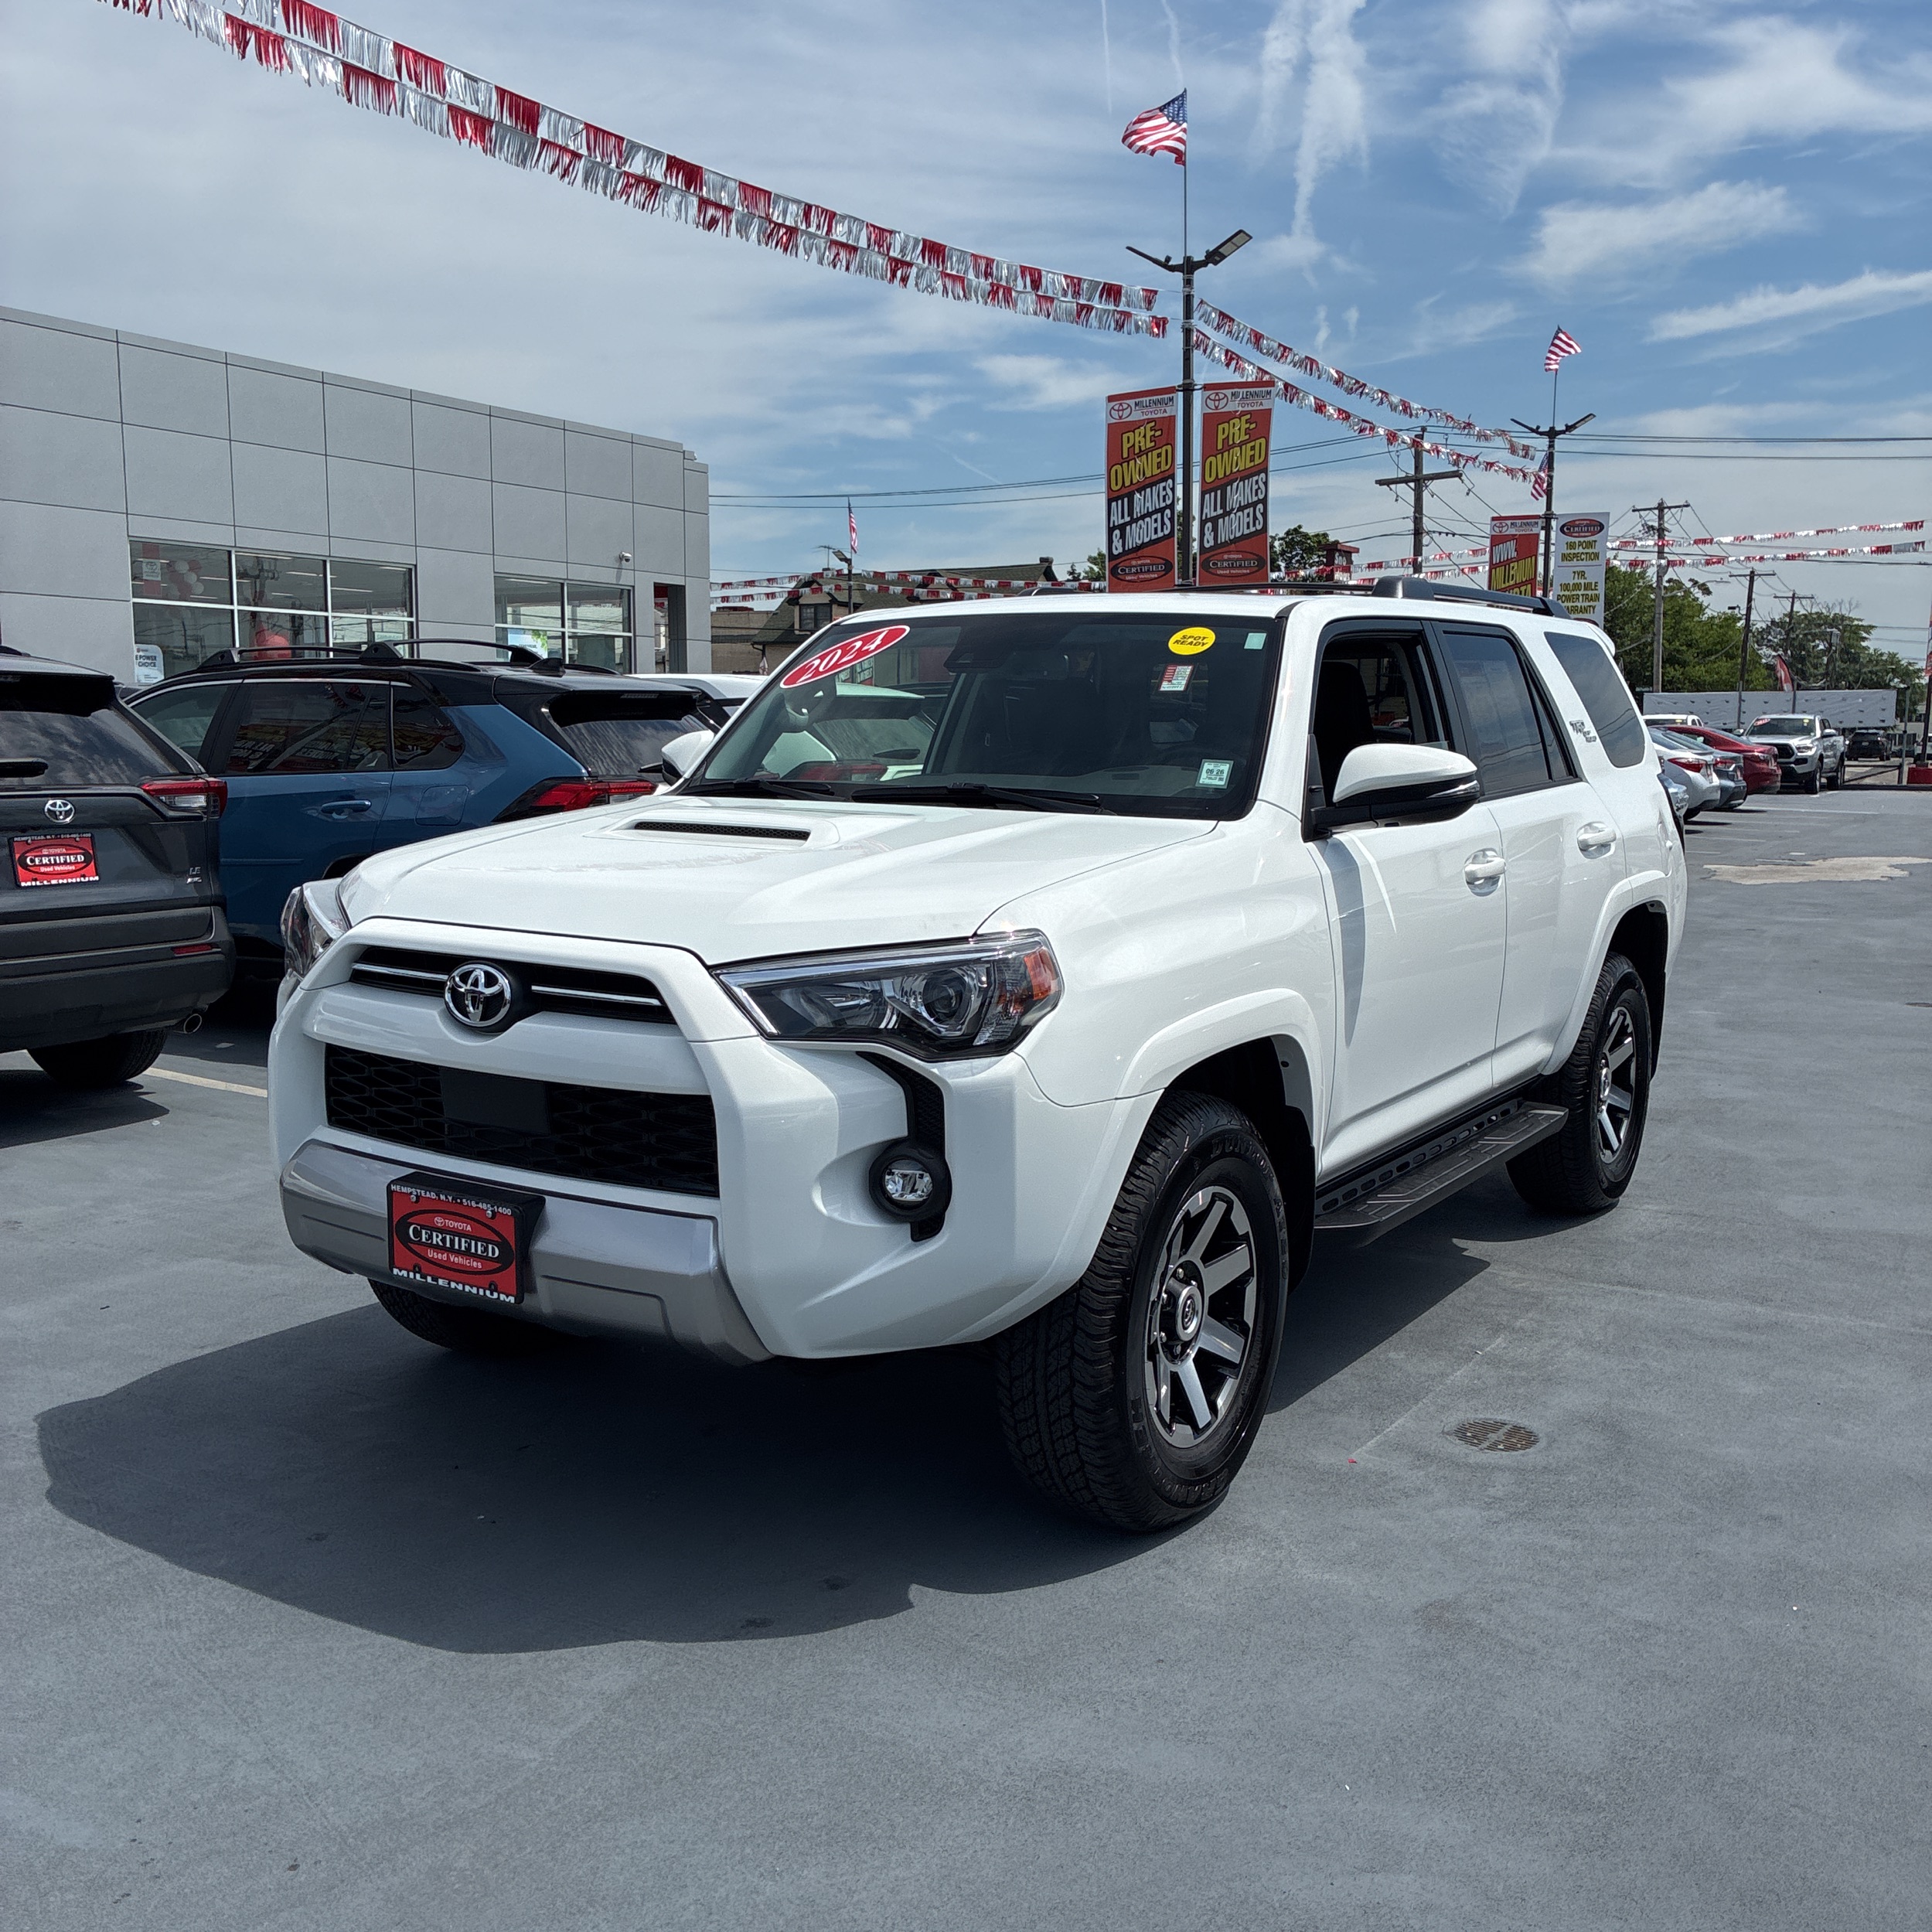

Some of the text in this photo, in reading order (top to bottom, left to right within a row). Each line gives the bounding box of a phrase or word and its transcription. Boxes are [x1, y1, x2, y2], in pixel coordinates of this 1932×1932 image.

[1134, 396, 1174, 409] MILLENNIUM
[1140, 408, 1167, 417] TOYOTA
[1217, 412, 1257, 451] PRE-
[1122, 421, 1163, 459] PRE-
[1109, 444, 1173, 492] OWNED
[1204, 438, 1266, 483] OWNED
[1109, 479, 1173, 527] ALL MAKES
[1202, 472, 1266, 520] ALL MAKES
[1112, 509, 1171, 555] & MODELS
[1204, 503, 1264, 548] & MODELS
[1578, 540, 1597, 550] POINT
[1209, 560, 1258, 568] CERTIFIED
[1561, 551, 1600, 562] INSPECTION
[1118, 564, 1165, 574] CERTIFIED
[1583, 581, 1598, 591] MILE
[1557, 593, 1600, 603] POWER TRAIN
[1564, 605, 1596, 615] ARRANTY
[796, 629, 889, 683] 2024
[26, 854, 84, 865] CERTIFIED
[21, 875, 100, 887] MILLENNIUM
[445, 1219, 472, 1232] TOYOTA
[408, 1224, 500, 1258] CERTIFIED
[428, 1249, 482, 1269] Used Vehicles
[393, 1268, 515, 1303] MILLENNIUM
